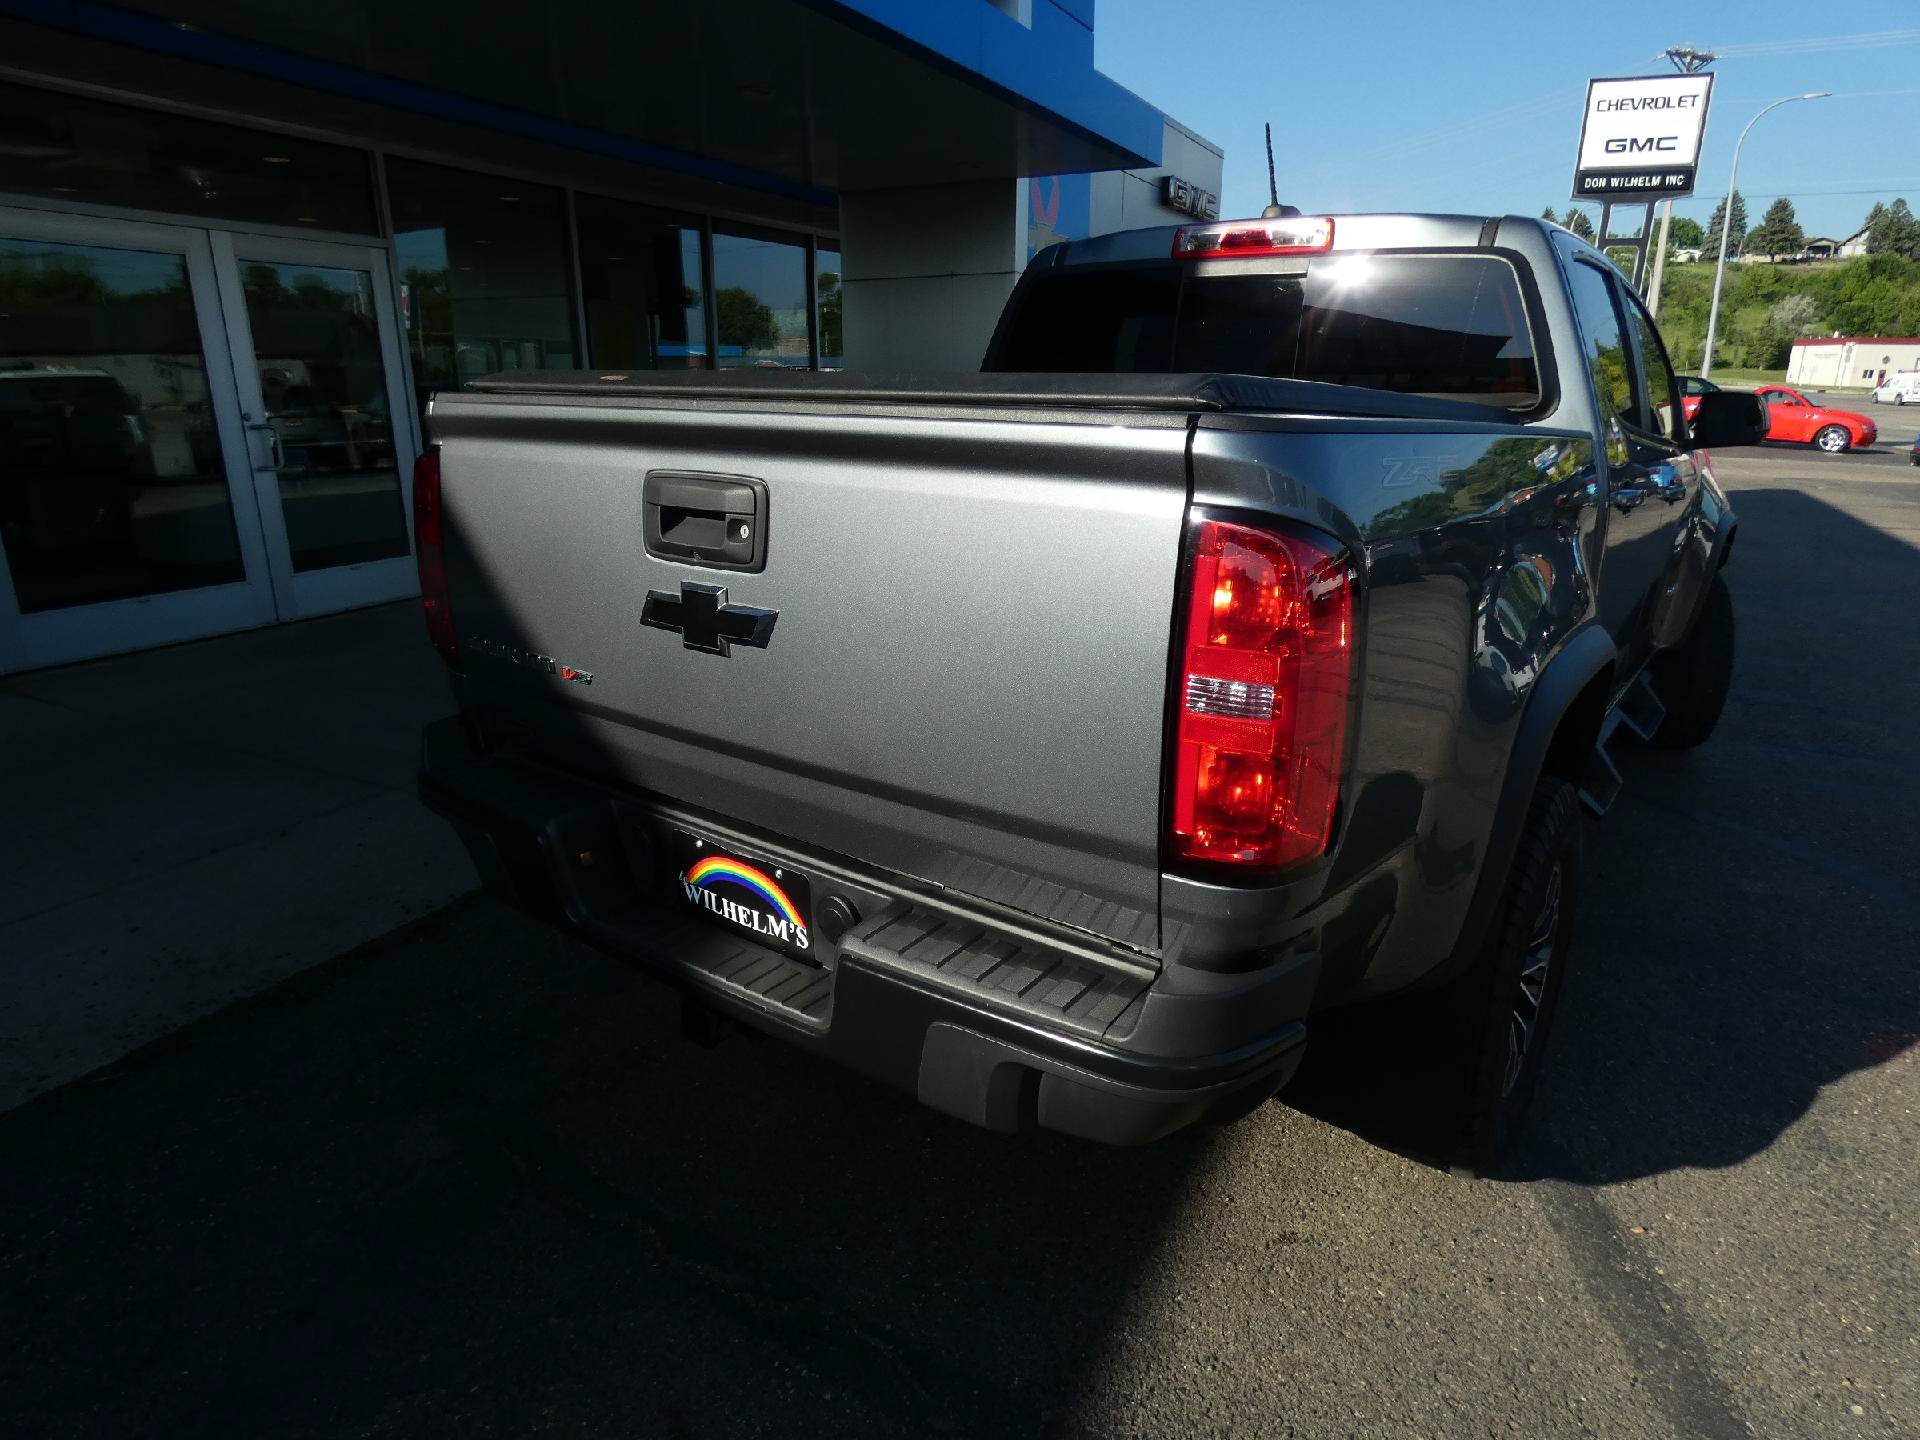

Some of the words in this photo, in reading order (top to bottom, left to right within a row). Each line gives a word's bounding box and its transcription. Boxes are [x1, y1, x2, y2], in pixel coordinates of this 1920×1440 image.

[1596, 94, 1700, 112] CHEVROLET
[1604, 136, 1678, 153] GMC
[1584, 177, 1606, 188] DON
[1610, 175, 1662, 188] WILHELM
[1665, 174, 1685, 186] INC
[1166, 175, 1217, 220] GMC
[682, 876, 809, 949] WILHELM'S
